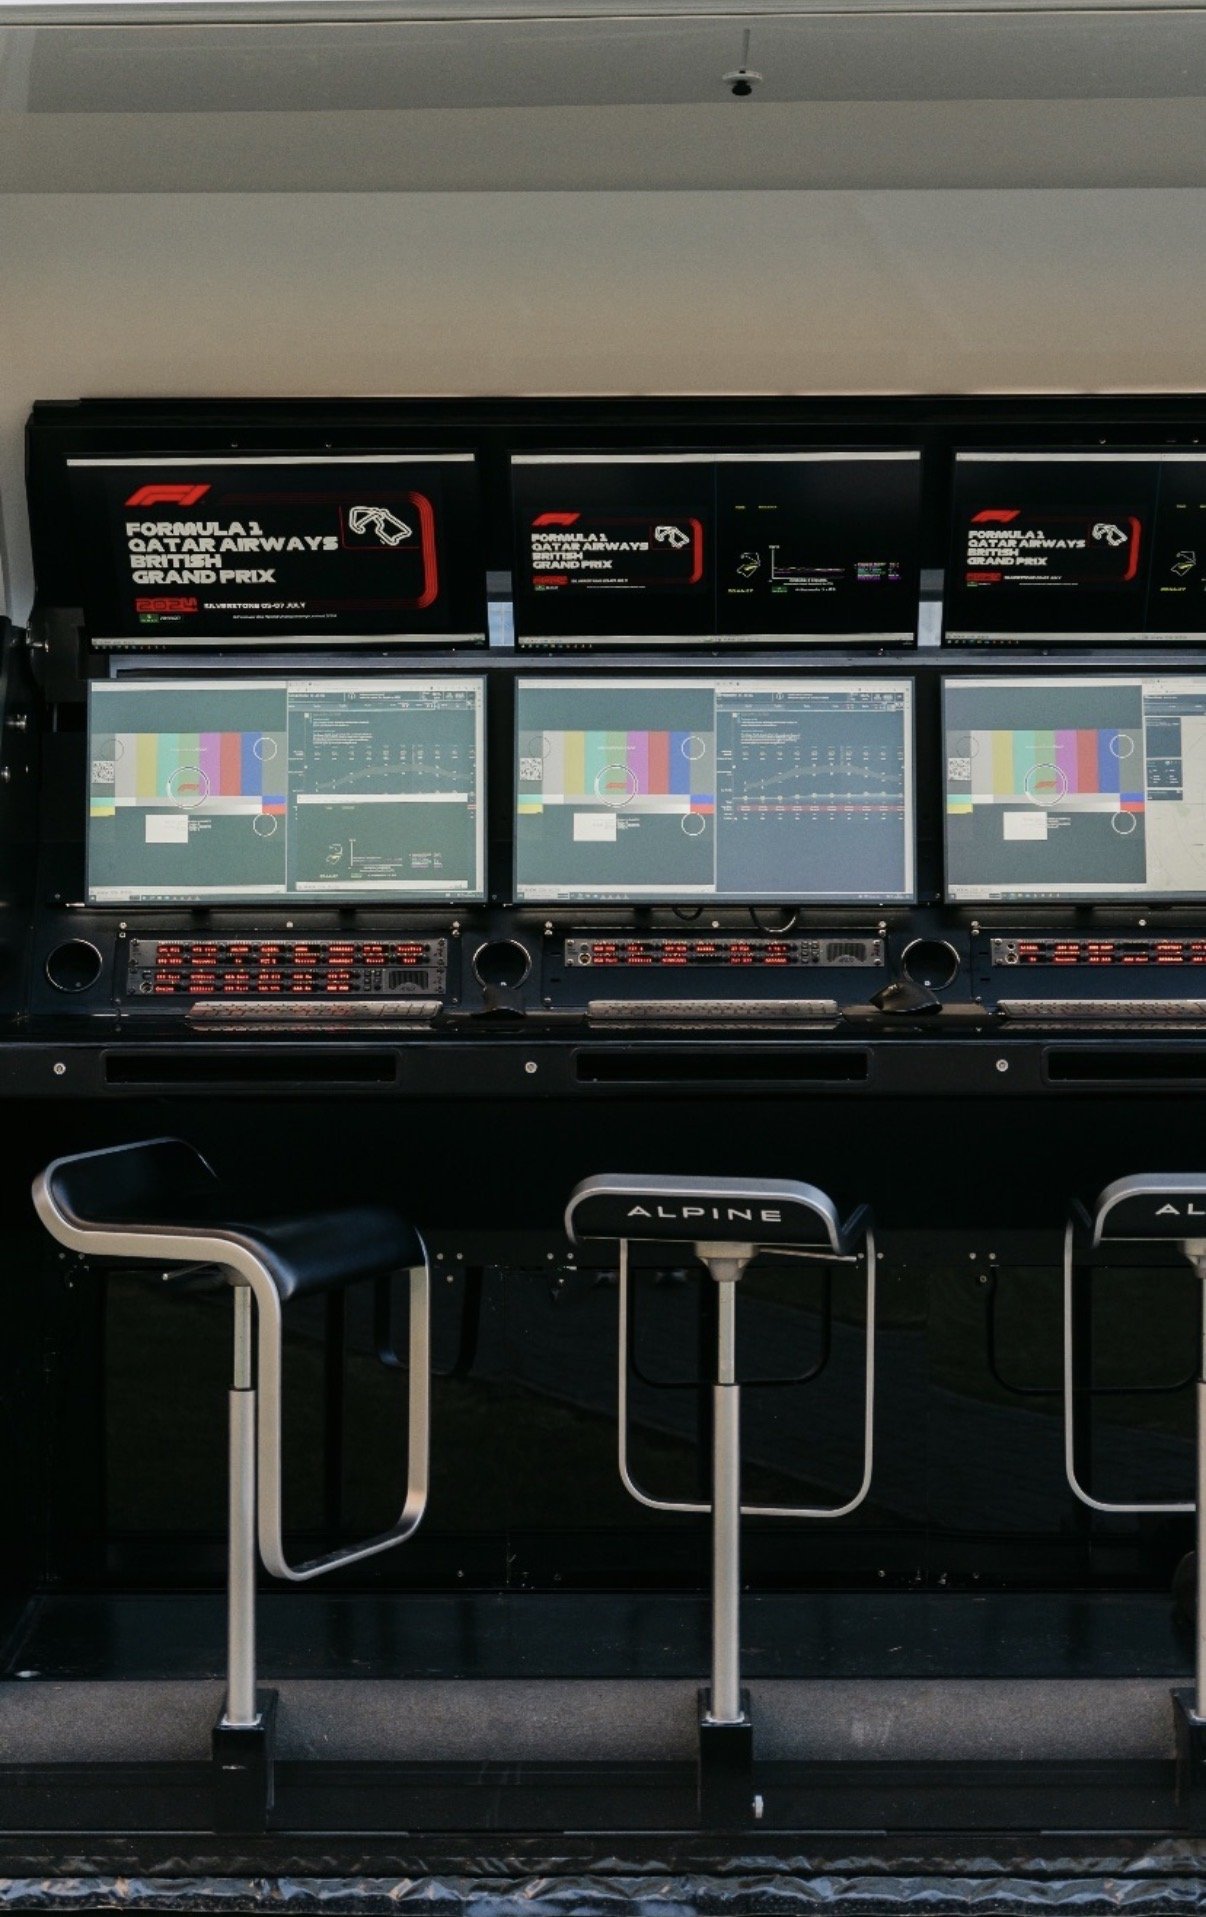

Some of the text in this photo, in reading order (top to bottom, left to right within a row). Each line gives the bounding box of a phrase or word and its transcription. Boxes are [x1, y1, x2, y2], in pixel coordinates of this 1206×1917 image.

[126, 521, 263, 536] FORMULA 1
[531, 533, 608, 542] FORMULA 1
[968, 530, 1036, 540] FORMULA
[128, 536, 339, 552] QATAR AIRWAYS
[532, 542, 649, 551] QATAR AIRWAYS
[968, 538, 1086, 548] QATAR AIRWAYS
[532, 552, 583, 561] BRITISH
[967, 548, 1019, 557] BRITISH
[130, 554, 222, 568] BRITISH
[533, 560, 613, 569] GRAND PRIX
[967, 556, 1048, 566] GRAND PRIX
[132, 569, 276, 584] GRAND PRIX
[136, 598, 198, 612] 2024
[627, 1206, 782, 1222] ALPINE
